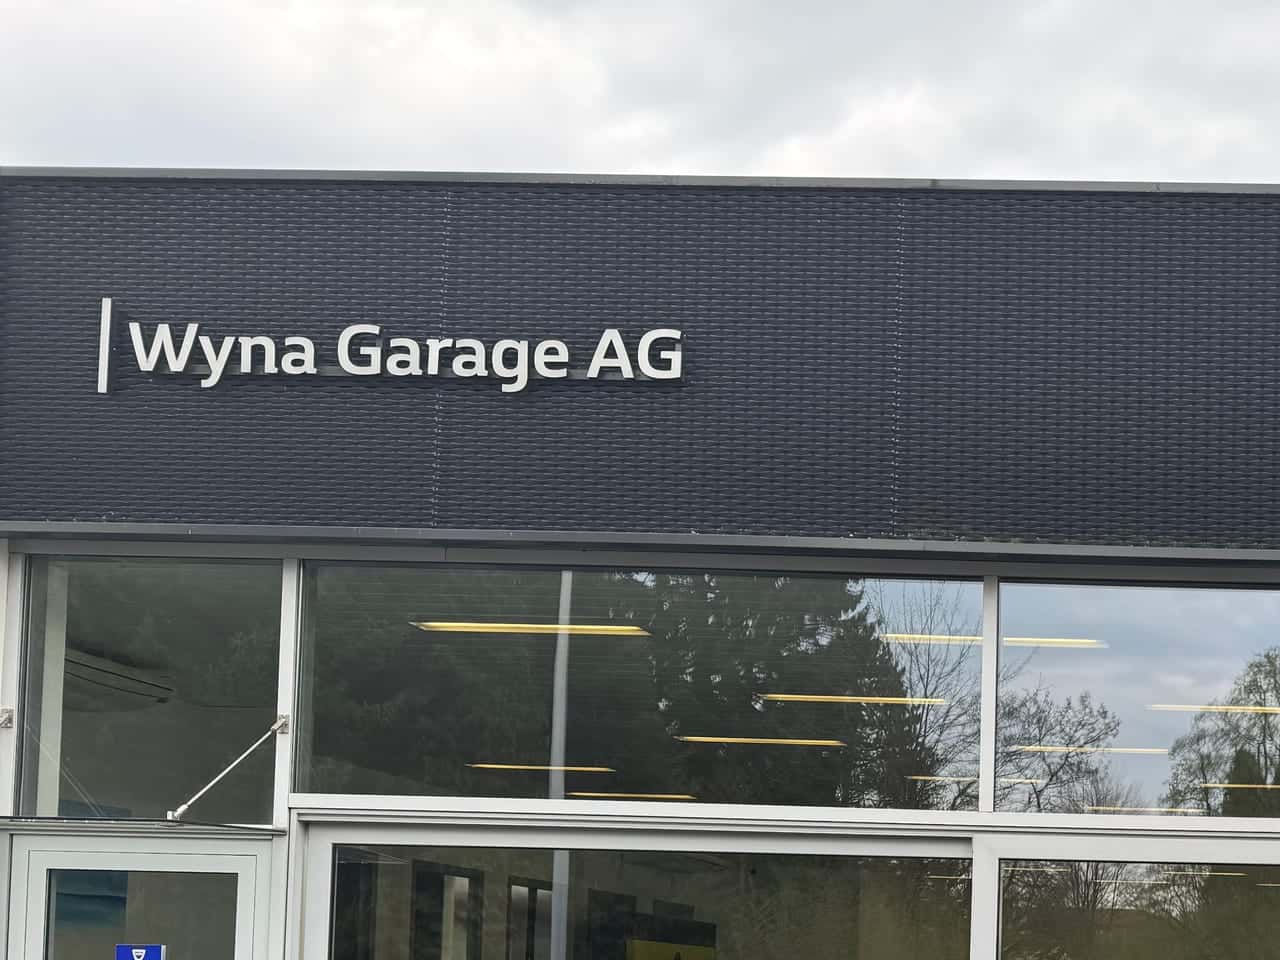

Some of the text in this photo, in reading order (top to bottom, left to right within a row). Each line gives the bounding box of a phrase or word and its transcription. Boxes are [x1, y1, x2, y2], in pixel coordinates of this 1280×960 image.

[128, 321, 684, 393] Wyna Garage AG
